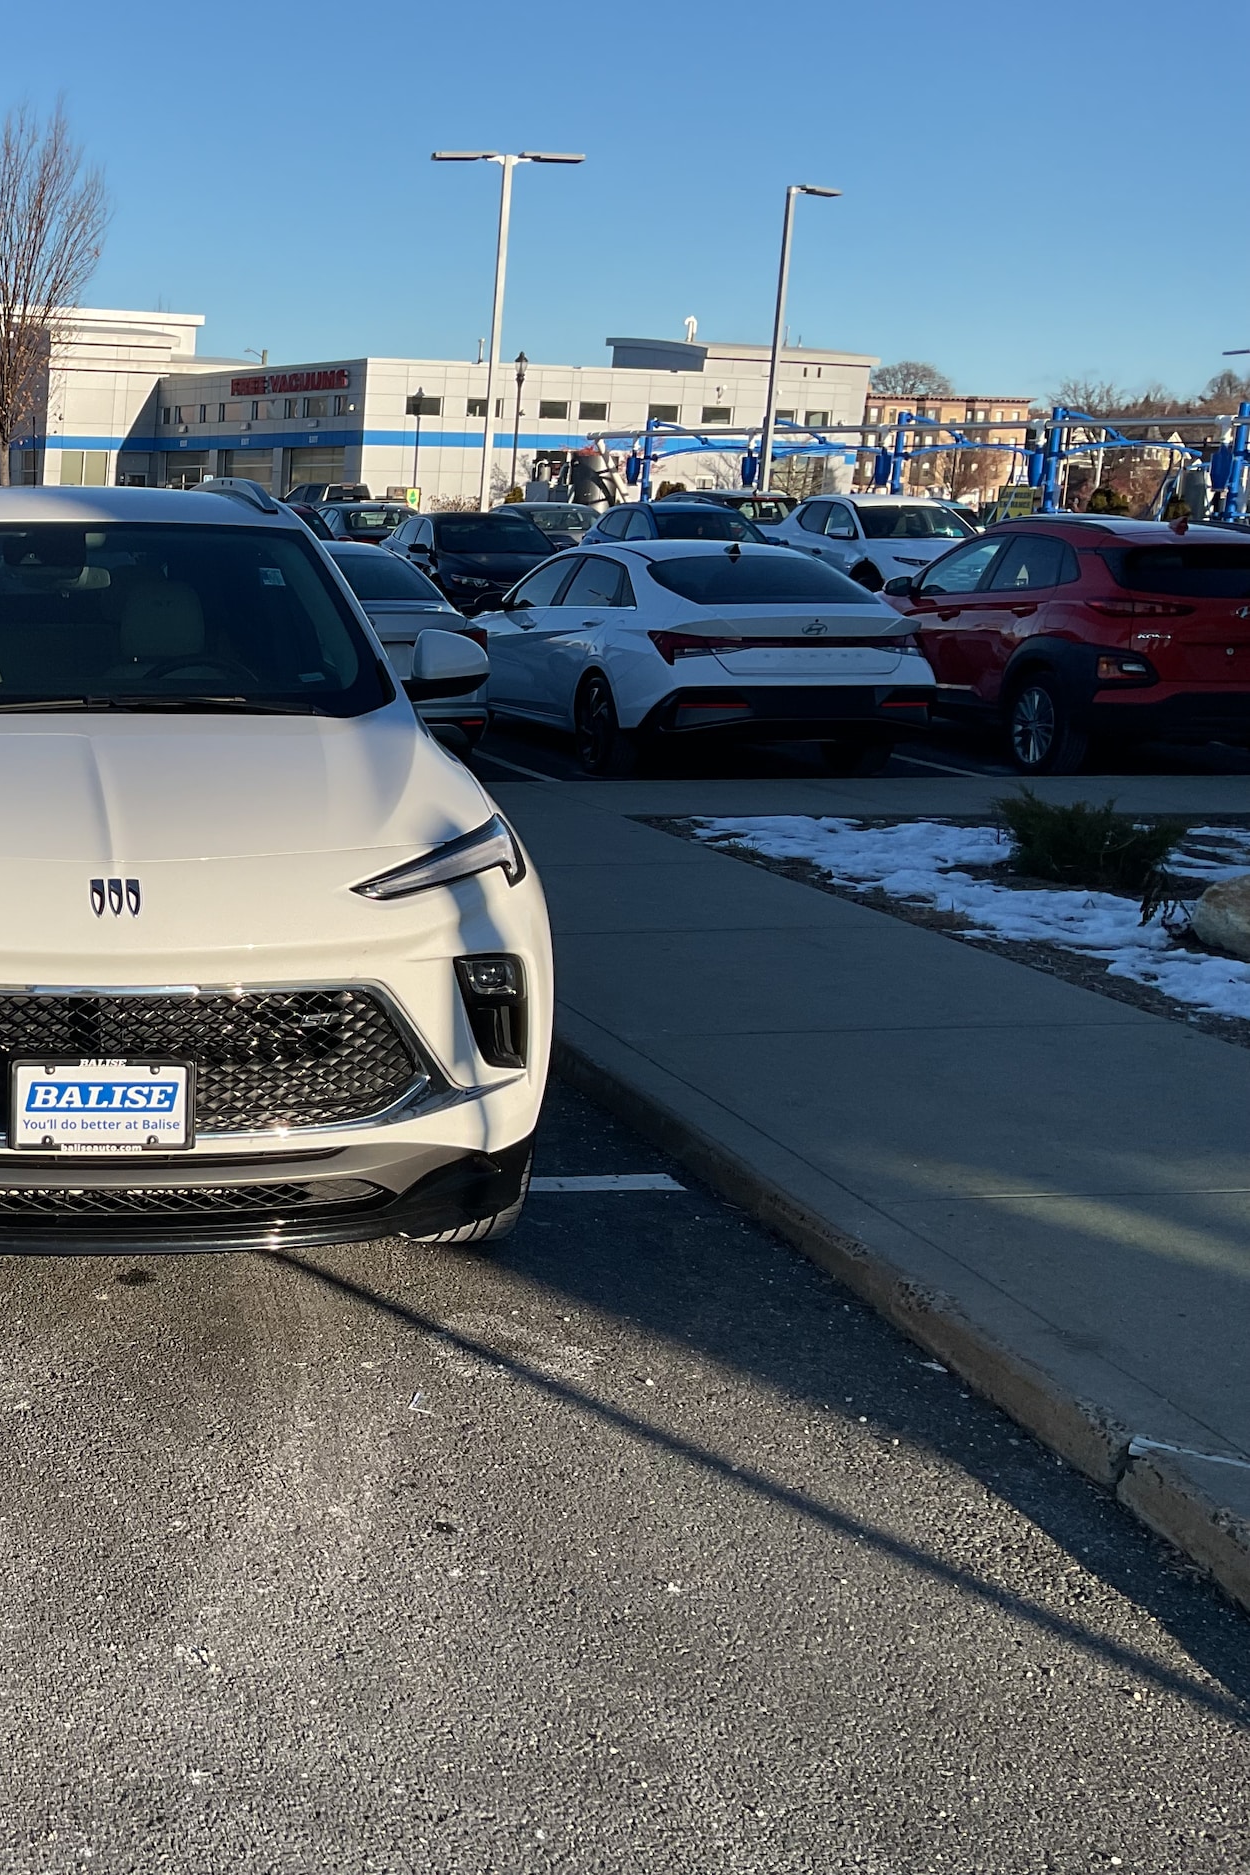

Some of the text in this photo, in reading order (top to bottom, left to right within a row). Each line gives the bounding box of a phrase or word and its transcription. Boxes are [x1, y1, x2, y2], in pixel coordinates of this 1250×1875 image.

[231, 369, 349, 396] FREE VACUUMS
[79, 1059, 127, 1067] BALISE
[30, 1086, 174, 1108] BALISE
[23, 1119, 180, 1130] You'll do better at Balise
[60, 1144, 143, 1152] baliseauto.com
